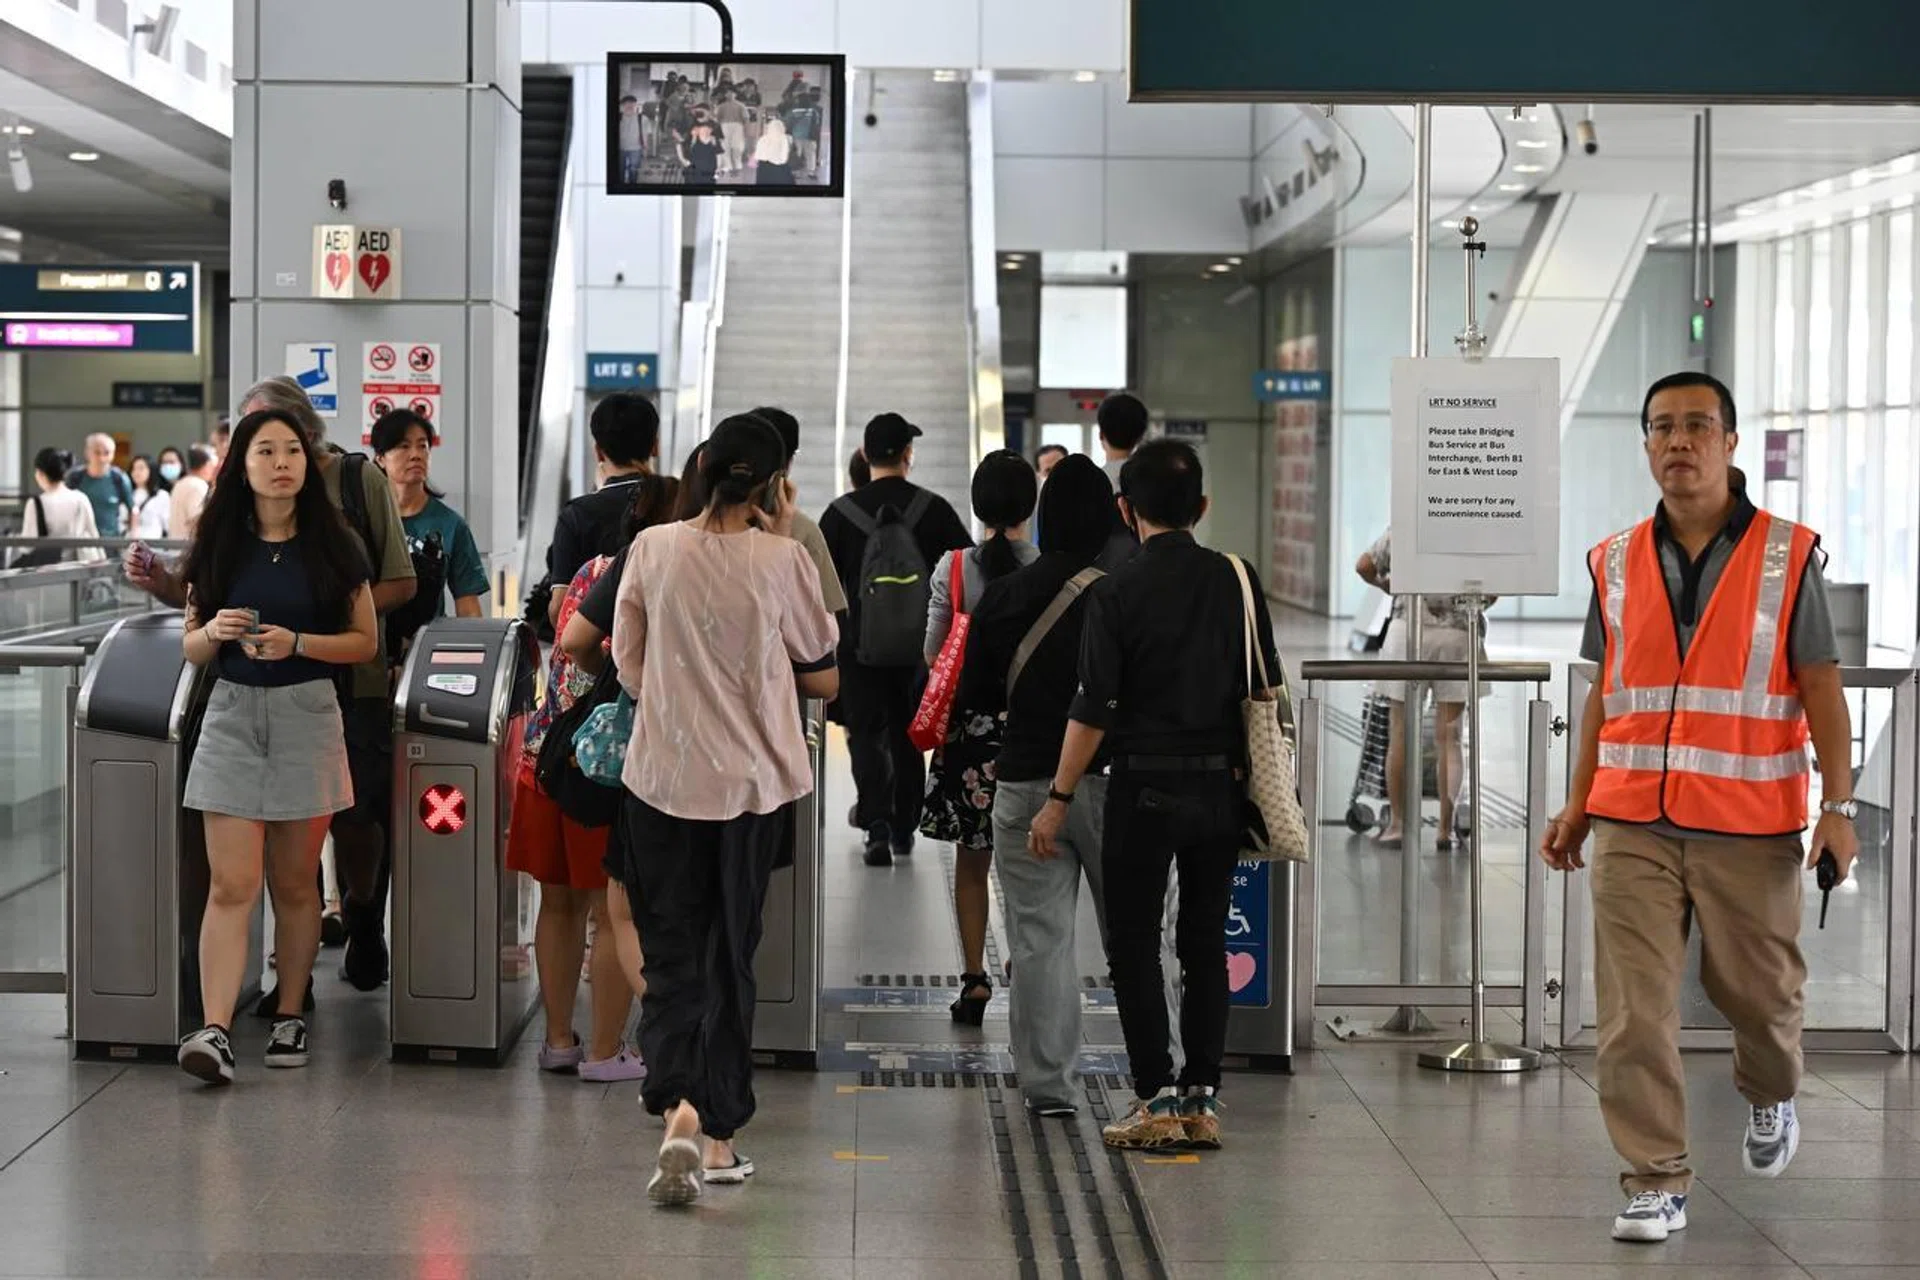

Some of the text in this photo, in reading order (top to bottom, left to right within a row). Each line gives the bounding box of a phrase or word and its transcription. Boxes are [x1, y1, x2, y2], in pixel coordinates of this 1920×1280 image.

[325, 230, 350, 250] AED
[358, 231, 390, 251] AED
[1429, 398, 1496, 407] LRT NO SERVICE
[1428, 427, 1456, 435] Please
[1479, 428, 1514, 437] Bridging
[1428, 441, 1444, 449] Bus
[1446, 441, 1477, 449] Service
[1489, 441, 1505, 449] Bus
[1428, 455, 1481, 464] Interchange,
[1486, 455, 1510, 463] Berth
[1428, 467, 1441, 475] for
[1443, 467, 1460, 475] East
[1463, 467, 1470, 475] &
[1496, 468, 1518, 476] Loop
[1428, 496, 1443, 504] We
[1461, 498, 1483, 506] sorry
[1484, 496, 1497, 504] for
[1499, 498, 1515, 506] any
[1233, 876, 1248, 886] se
